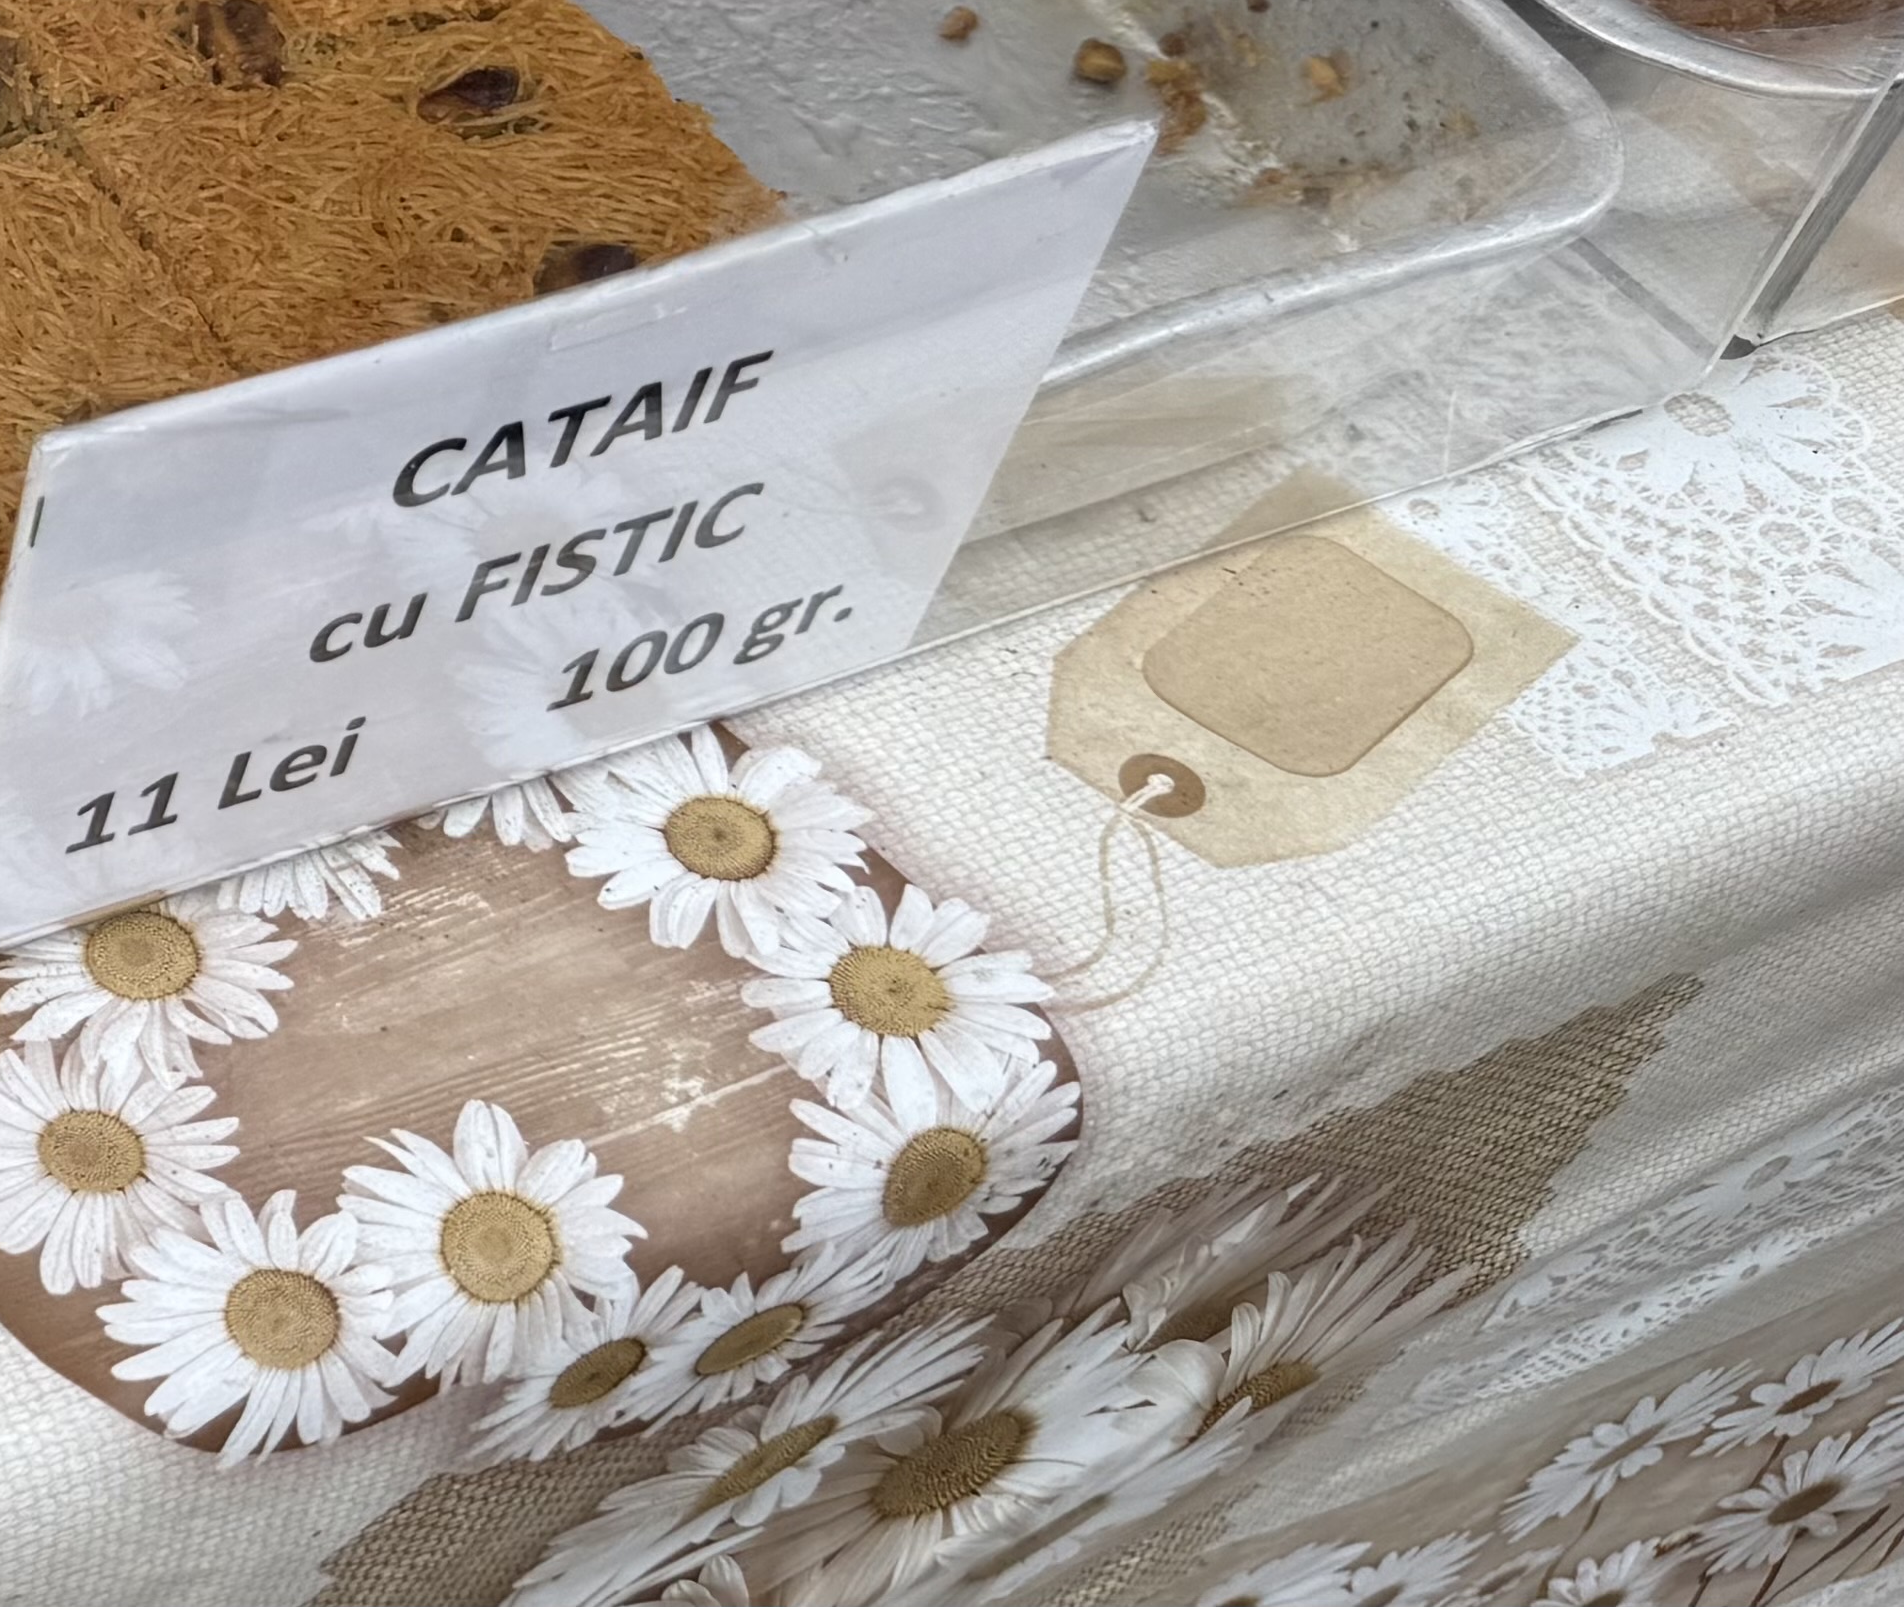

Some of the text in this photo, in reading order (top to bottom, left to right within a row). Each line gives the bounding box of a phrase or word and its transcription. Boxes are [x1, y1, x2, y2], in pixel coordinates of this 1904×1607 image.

[391, 348, 776, 509] CATAIF
[308, 481, 765, 664] cu FISTIC
[64, 584, 853, 855] 11 Lei 100 gr.
